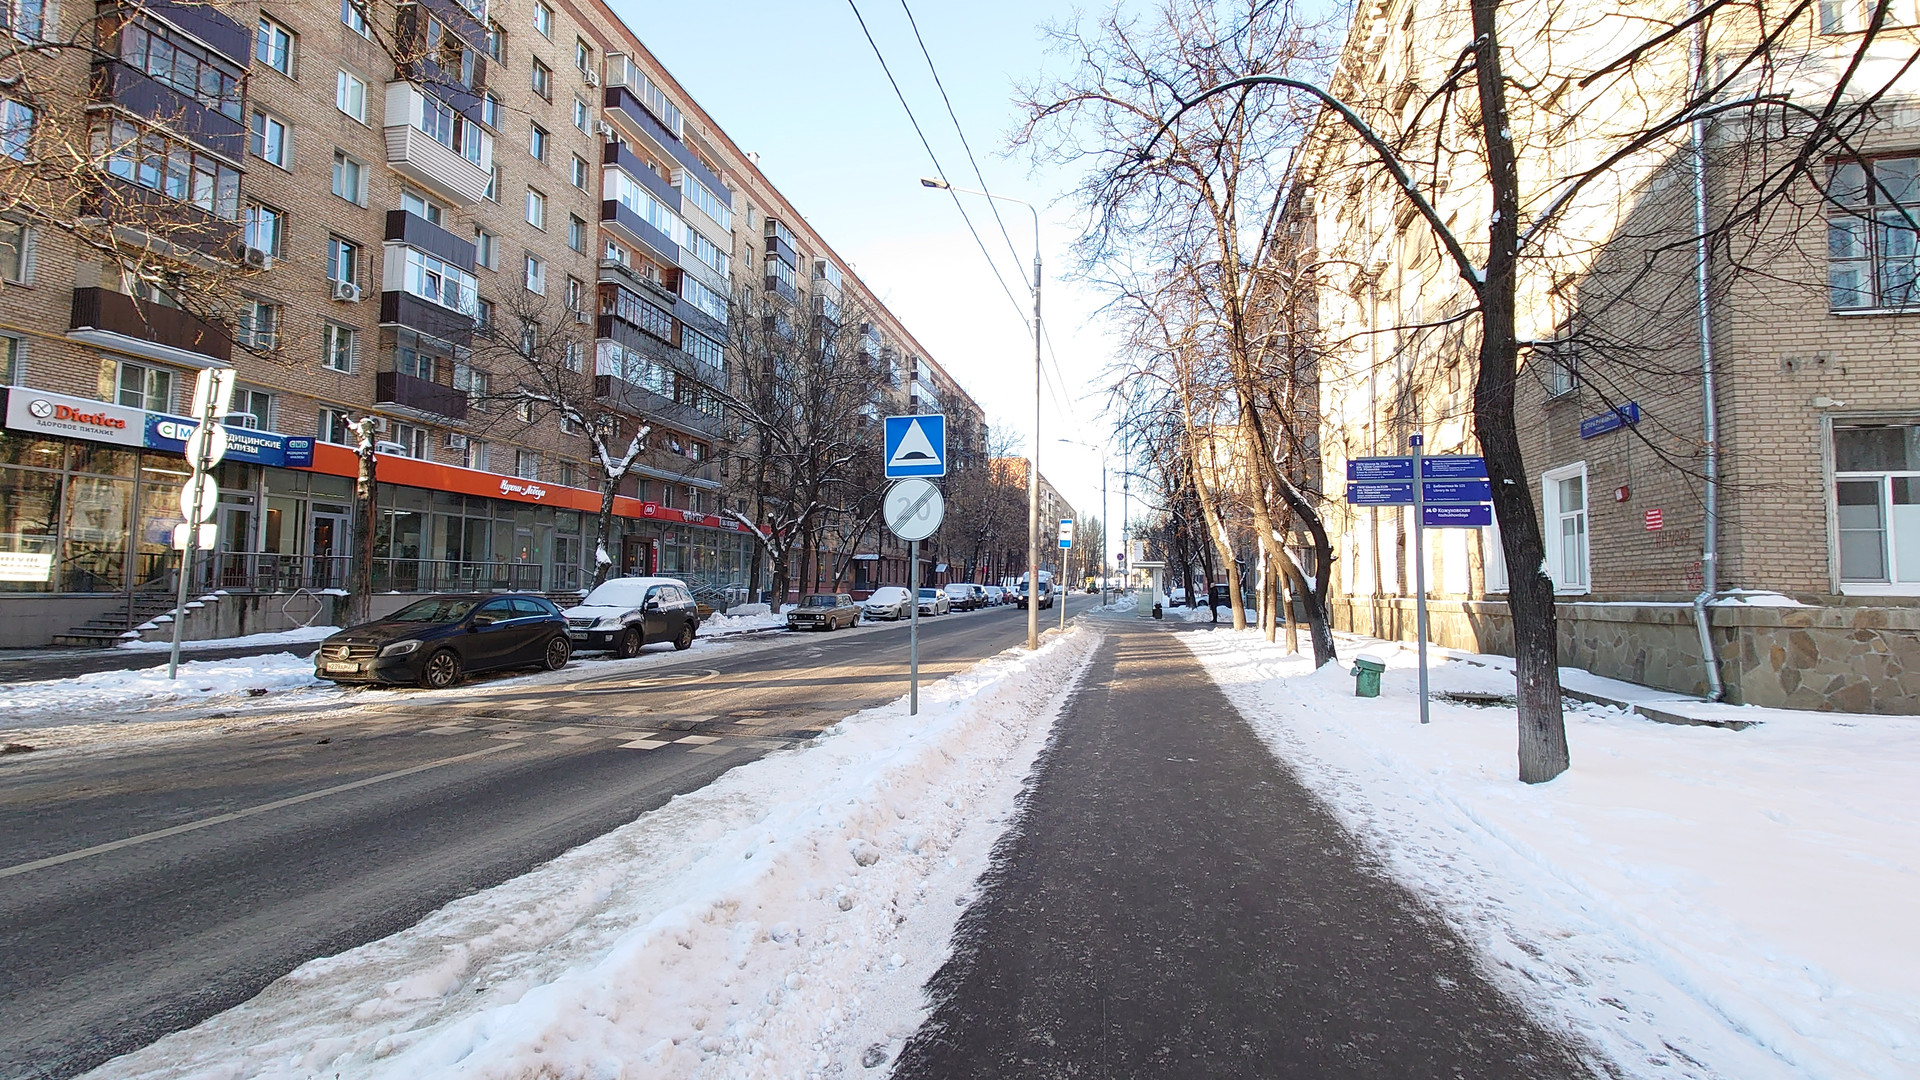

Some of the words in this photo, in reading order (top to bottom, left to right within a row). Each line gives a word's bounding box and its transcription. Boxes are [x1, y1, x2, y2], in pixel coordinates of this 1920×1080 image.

[54, 404, 126, 429] Dietica
[36, 420, 77, 431] ЗДОРОВОЕ
[80, 426, 114, 436] ПИТАНИЕ
[162, 424, 191, 438] CM
[225, 432, 282, 449] ЕДИЦИНСКИЕ
[227, 443, 259, 454] АЛИЗЫ
[896, 497, 931, 521] 20
